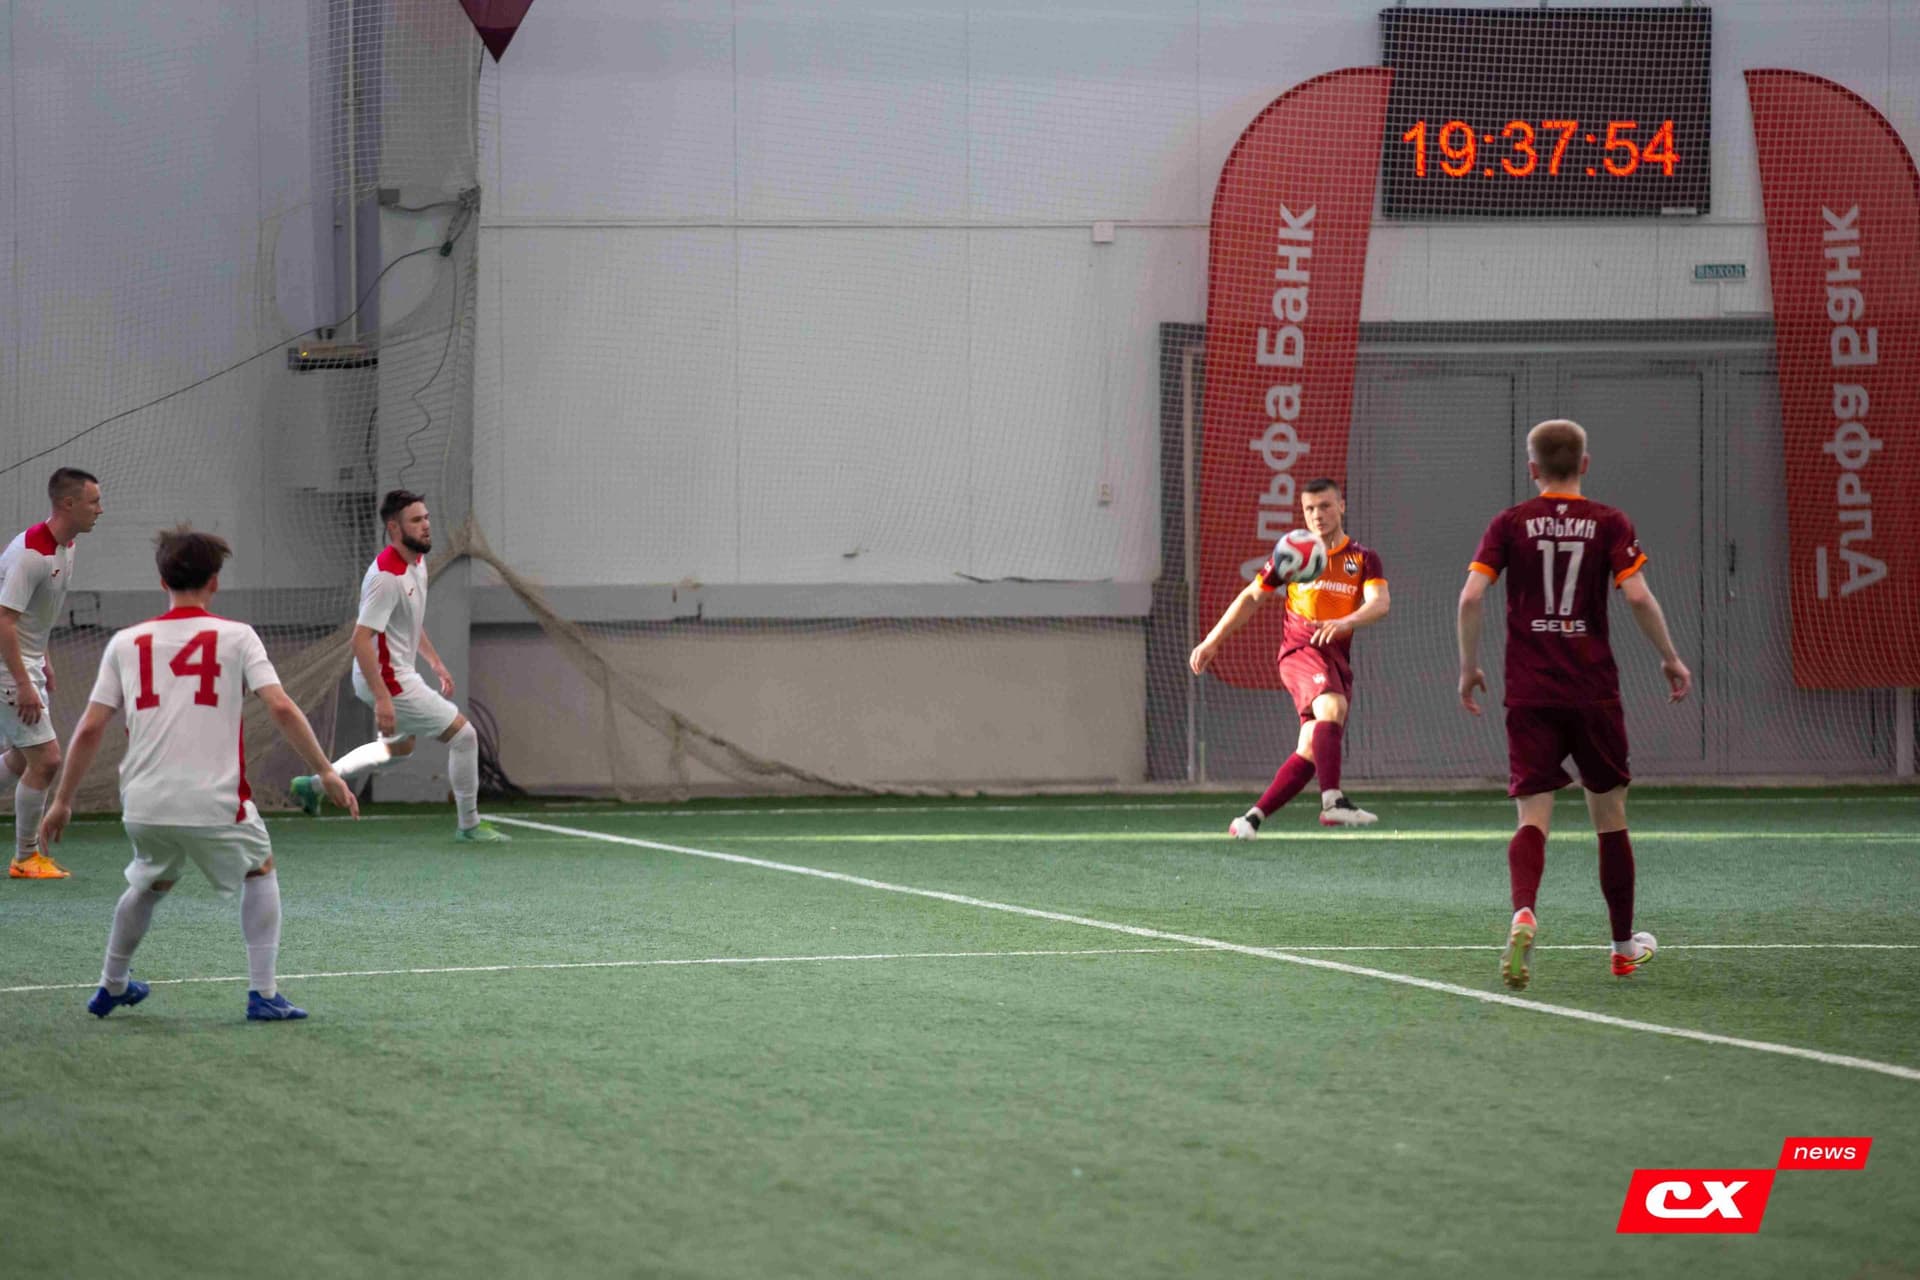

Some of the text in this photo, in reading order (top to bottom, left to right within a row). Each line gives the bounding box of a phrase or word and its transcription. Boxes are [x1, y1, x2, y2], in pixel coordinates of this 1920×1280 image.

[1402, 119, 1681, 178] 19:37:54
[1256, 203, 1317, 368] Банк
[1526, 516, 1597, 539] КУЗЬКИН
[1537, 540, 1585, 616] 17
[1531, 619, 1586, 632] SEUS
[134, 630, 221, 710] 14
